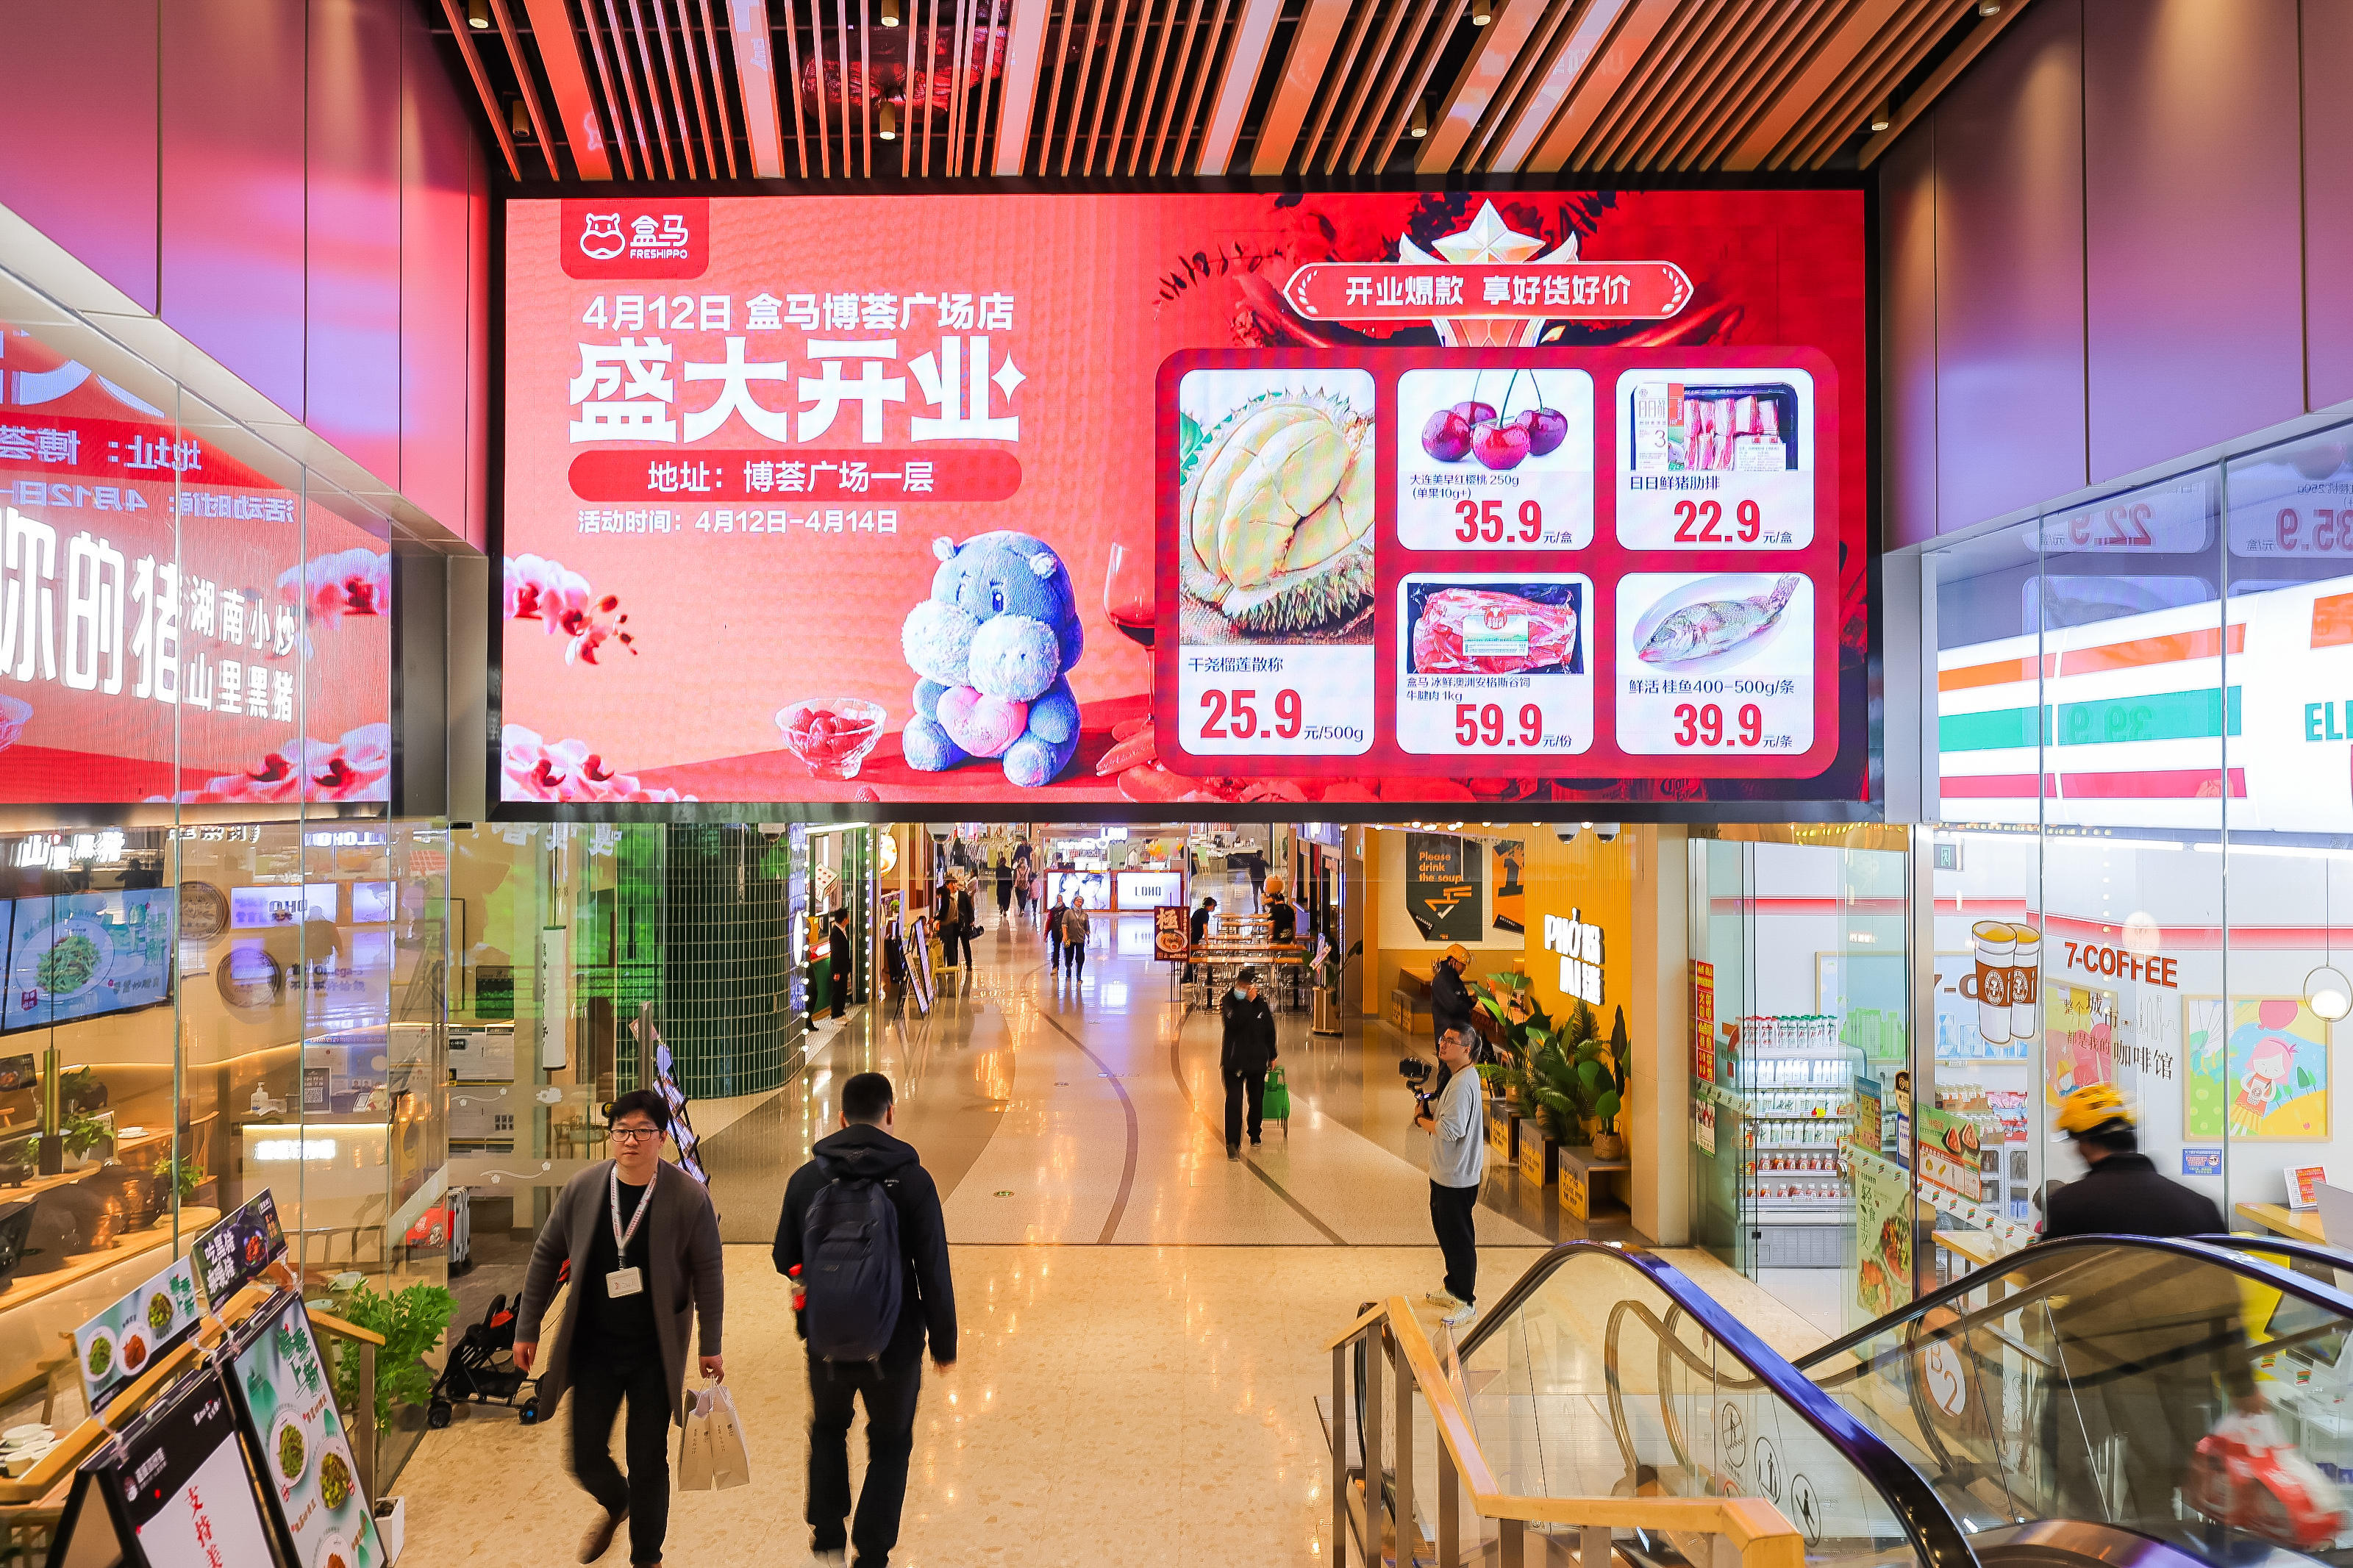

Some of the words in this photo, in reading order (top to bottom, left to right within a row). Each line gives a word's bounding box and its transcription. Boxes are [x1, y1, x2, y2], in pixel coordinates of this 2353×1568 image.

[630, 215, 689, 247] 盒马
[630, 249, 689, 259] FRESHIPPO
[1346, 275, 1463, 306] 开业爆款
[1482, 275, 1631, 306] 享好货好价
[582, 294, 731, 332] 4月12日
[745, 292, 1015, 332] 盒马博荟广场店
[569, 335, 1020, 443] 盛大开业
[1490, 475, 1519, 487] 250g
[1630, 476, 1720, 490] 日日鲜猪肋排
[1455, 500, 1542, 543] 35.9
[1543, 531, 1573, 544] 元/盒
[1674, 500, 1760, 543] 22.9
[1763, 531, 1793, 544] 元/盒
[190, 575, 296, 656] 湖南小炒
[1188, 656, 1283, 672] 干尧榴莲散称
[189, 652, 294, 723] 山里黑猪
[1443, 691, 1463, 704] 1kg
[1200, 689, 1302, 739] 25.9
[1304, 725, 1363, 742] 元/500g
[1455, 704, 1542, 747] 59.9
[1543, 734, 1572, 748] 元/份
[1674, 704, 1761, 747] 39.9
[1763, 734, 1793, 748] 元/条
[1418, 851, 1452, 862] Please
[1418, 862, 1446, 872] drink
[1135, 886, 1161, 897] LOHO
[1418, 873, 1435, 882] the
[2064, 941, 2178, 989] 7-COFFEE
[2064, 991, 2119, 1031] 整个城市
